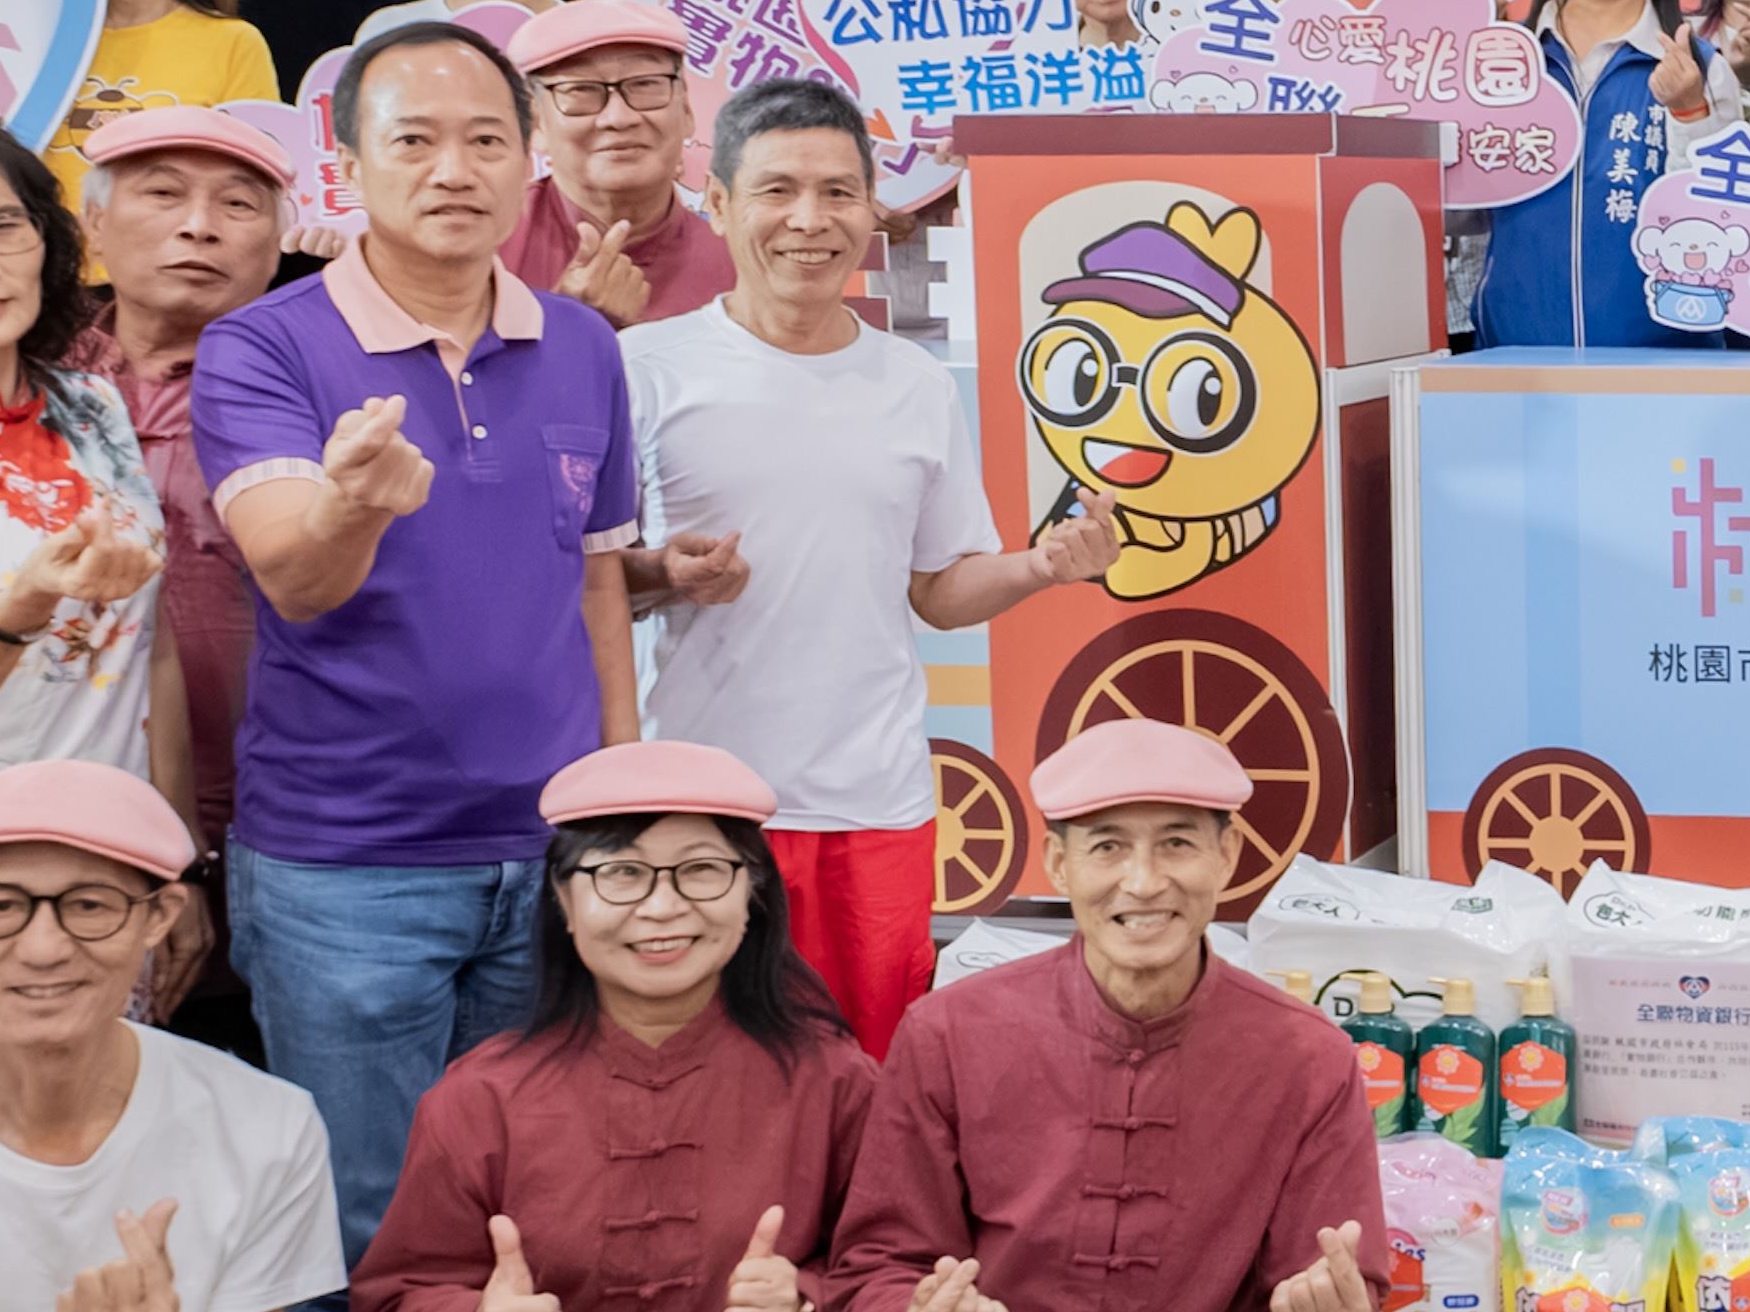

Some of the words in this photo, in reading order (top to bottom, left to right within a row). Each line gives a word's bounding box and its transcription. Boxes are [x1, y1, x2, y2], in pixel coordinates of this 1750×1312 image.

[898, 44, 1146, 116] 幸福洋溢
[1604, 111, 1642, 225] 陳美梅
